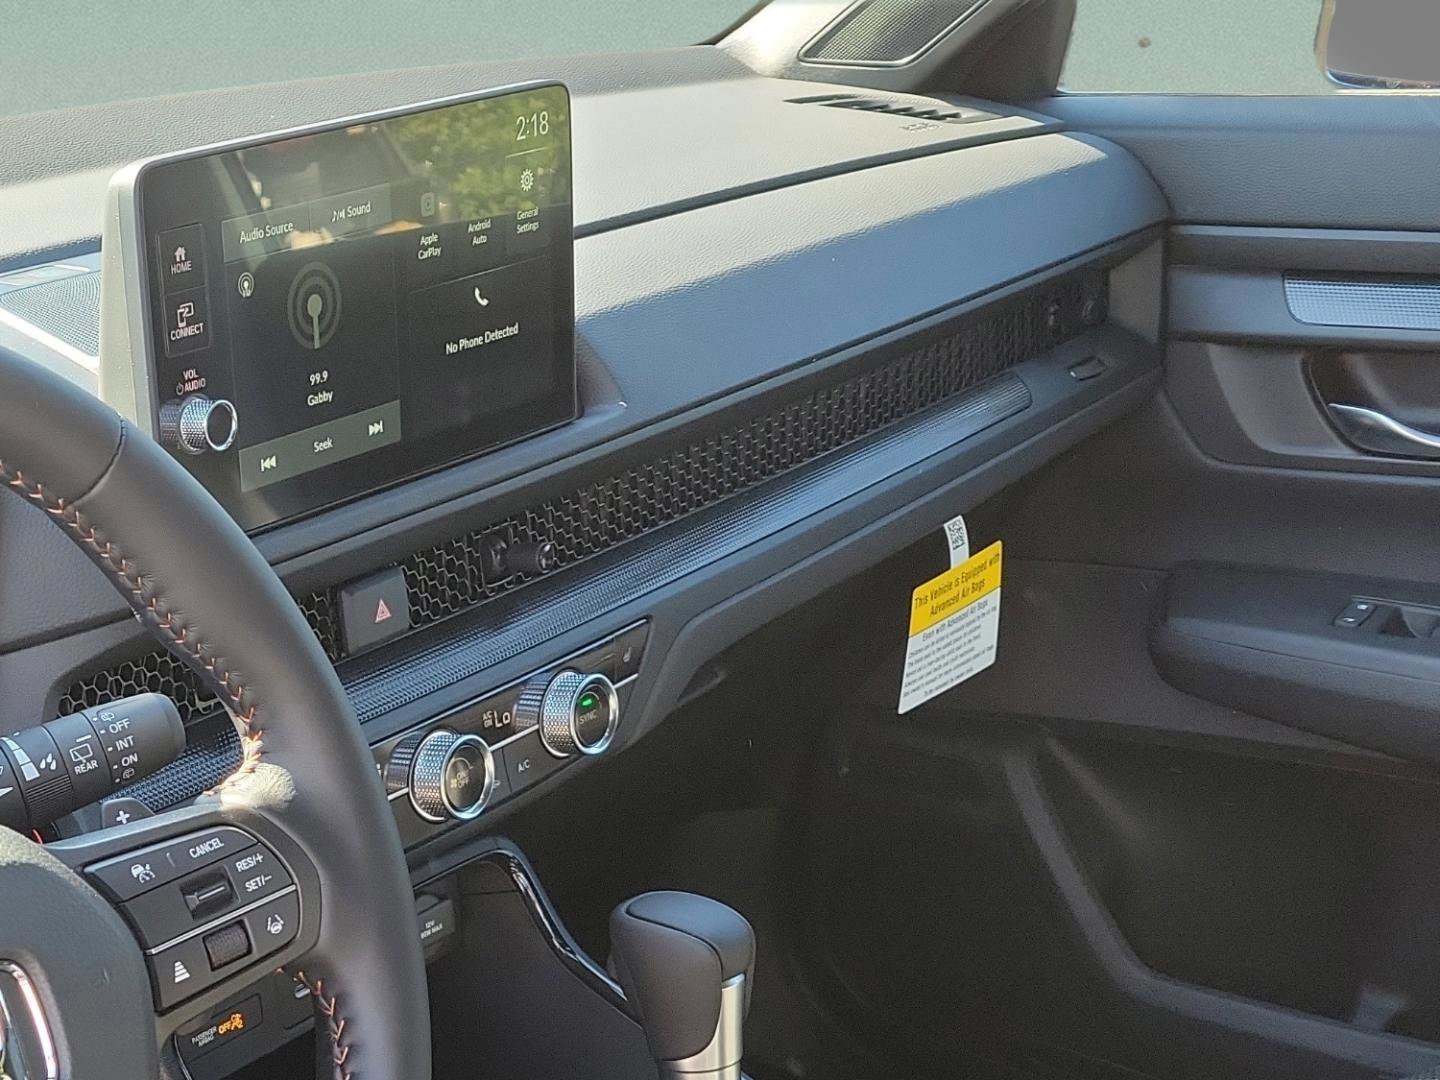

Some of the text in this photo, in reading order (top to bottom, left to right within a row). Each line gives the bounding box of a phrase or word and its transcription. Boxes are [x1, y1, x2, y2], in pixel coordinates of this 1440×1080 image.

[516, 111, 549, 141] 2:18
[347, 201, 371, 218] Sound
[516, 207, 539, 220] General
[239, 222, 294, 244] Audio Source
[468, 219, 491, 233] Android
[516, 220, 540, 234] Settings
[420, 233, 439, 246] Apple
[472, 234, 487, 246] Auto
[418, 246, 442, 260] CarPlay
[171, 260, 193, 275] HOME
[170, 322, 204, 341] CONNECT
[446, 322, 519, 355] No Phone Detected
[183, 368, 199, 380] VOL
[309, 370, 329, 386] 99.9
[184, 378, 207, 392] AUDIO
[307, 390, 334, 406] Gabby
[313, 437, 334, 453] Seek
[914, 595, 929, 608] This
[930, 581, 953, 601] Vehicle
[579, 708, 599, 724] SYNC
[108, 719, 131, 734] OFF
[115, 735, 135, 751] INT
[74, 760, 99, 775] REAR
[121, 753, 138, 768] ON
[518, 759, 530, 773] A/C
[189, 837, 225, 859] CANCEL
